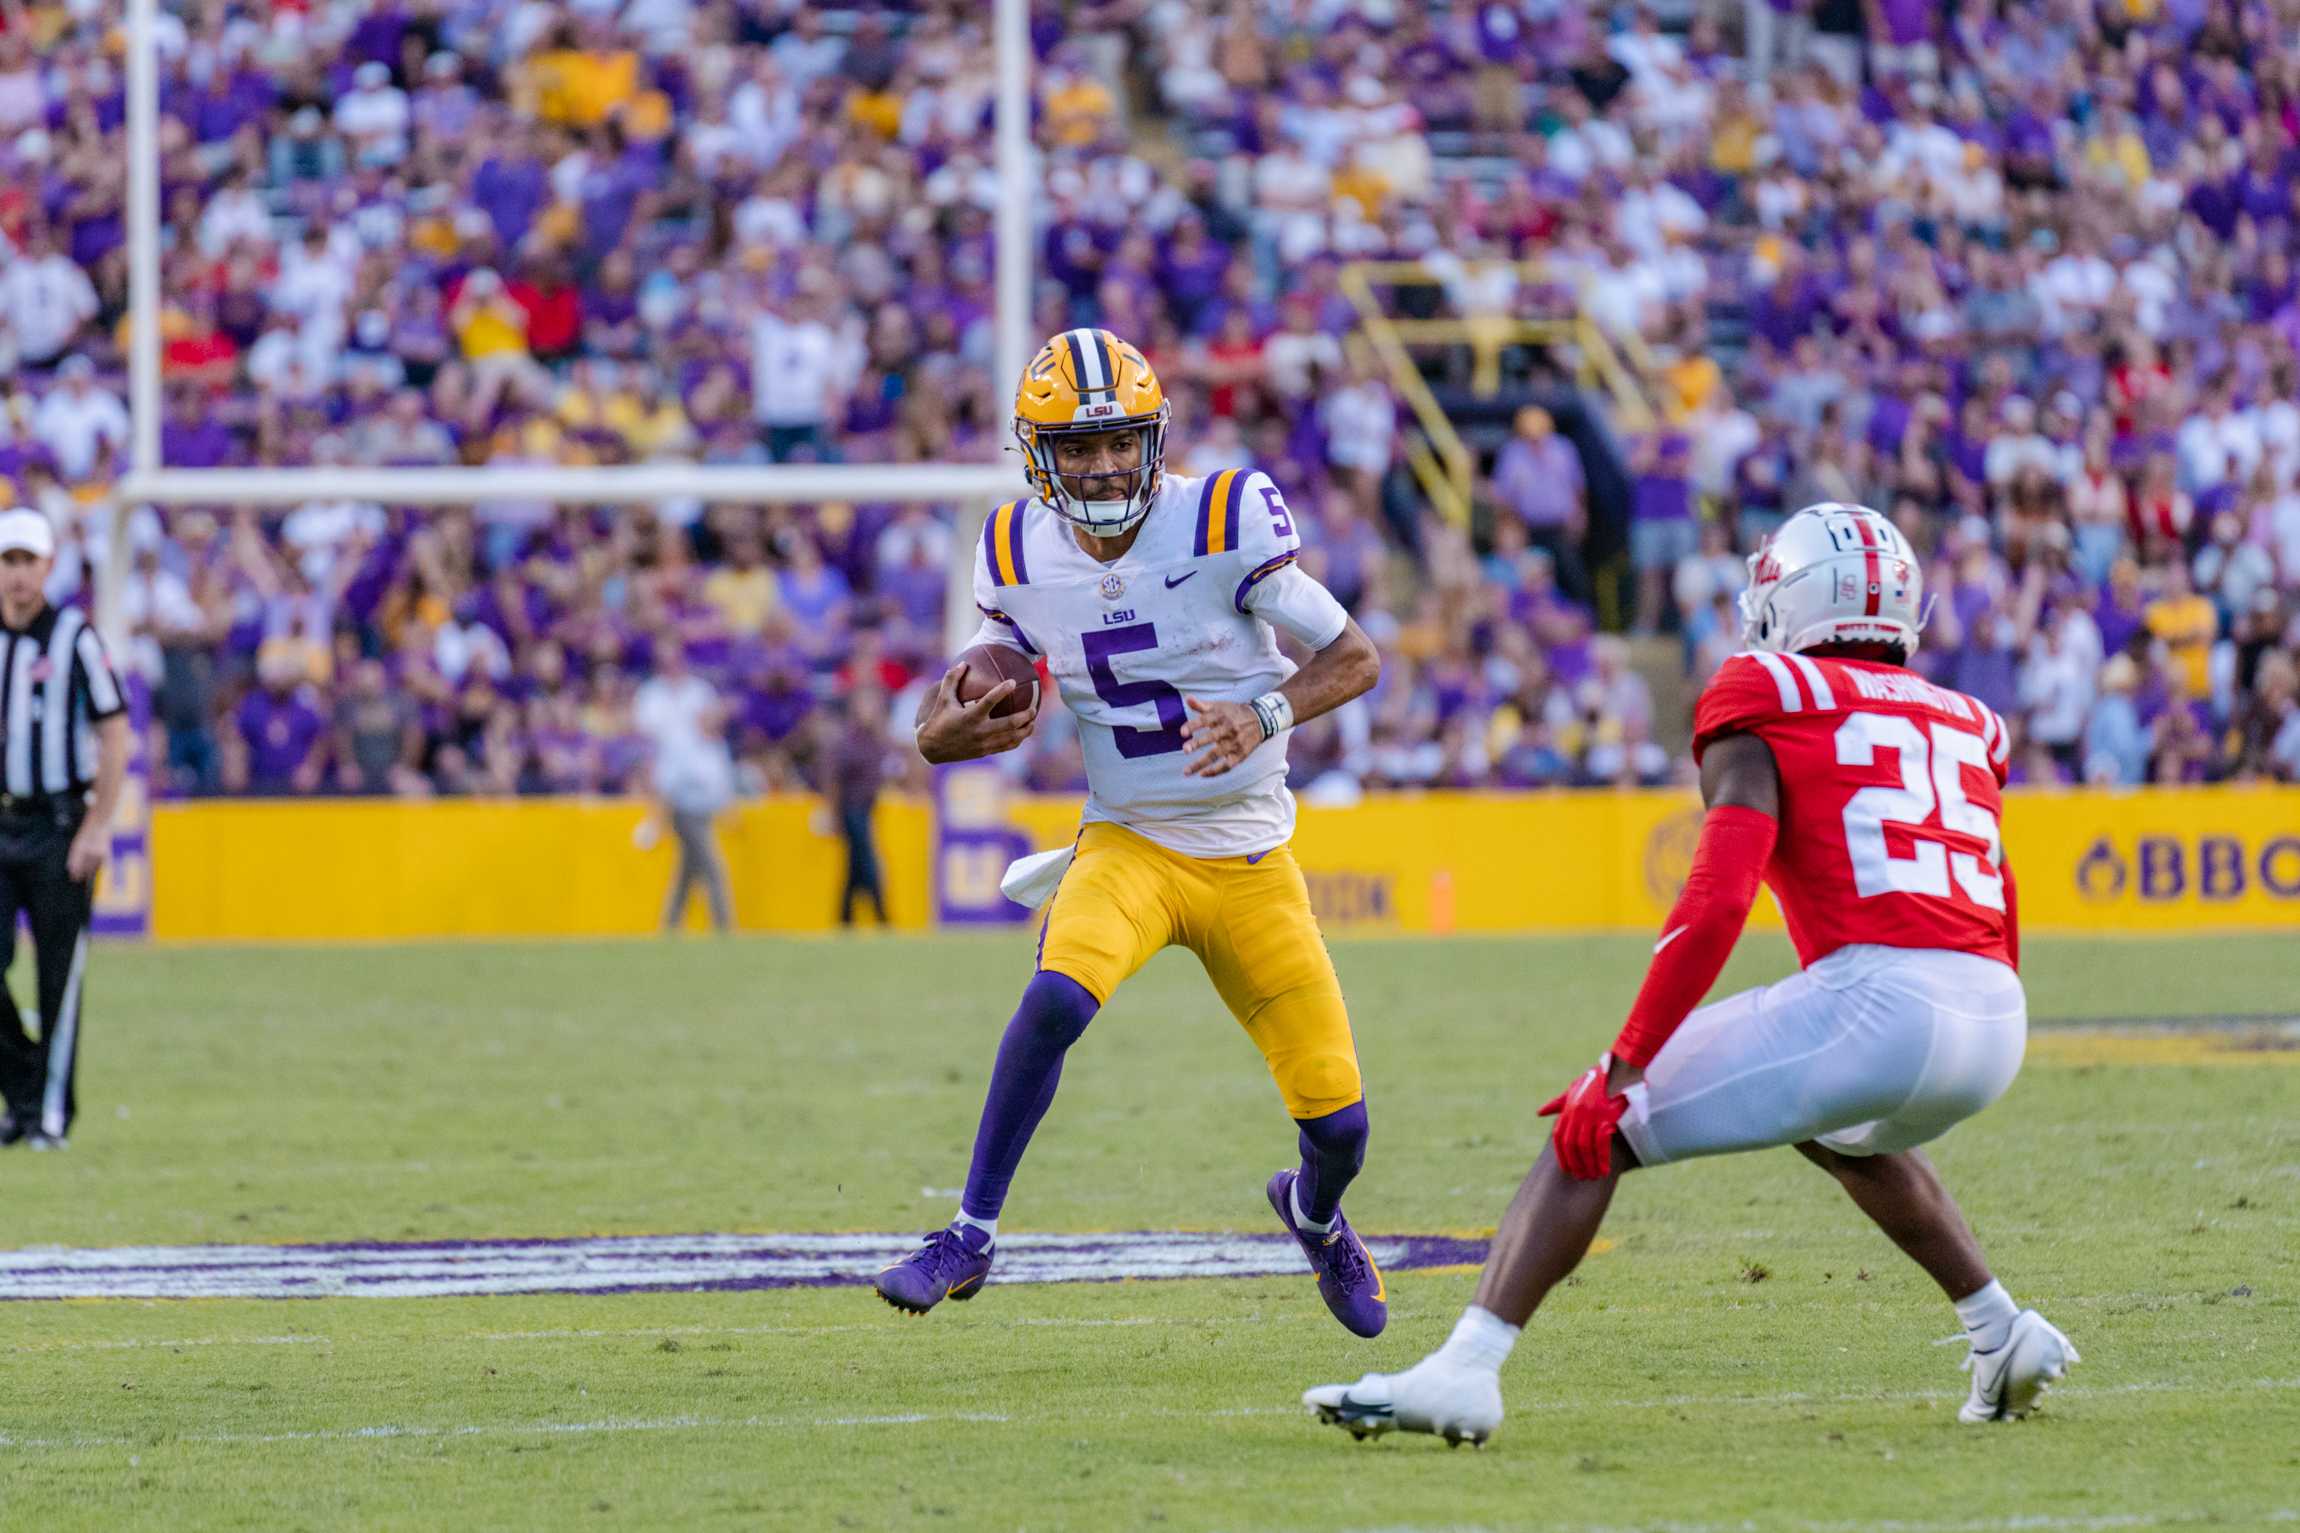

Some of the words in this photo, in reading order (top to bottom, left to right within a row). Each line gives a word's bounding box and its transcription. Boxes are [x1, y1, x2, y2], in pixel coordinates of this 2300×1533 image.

[1086, 405, 1113, 417] LSU
[1258, 487, 1293, 537] 5
[1102, 609, 1136, 625] LSU
[1081, 622, 1193, 759] 5
[1834, 711, 2006, 910] 25
